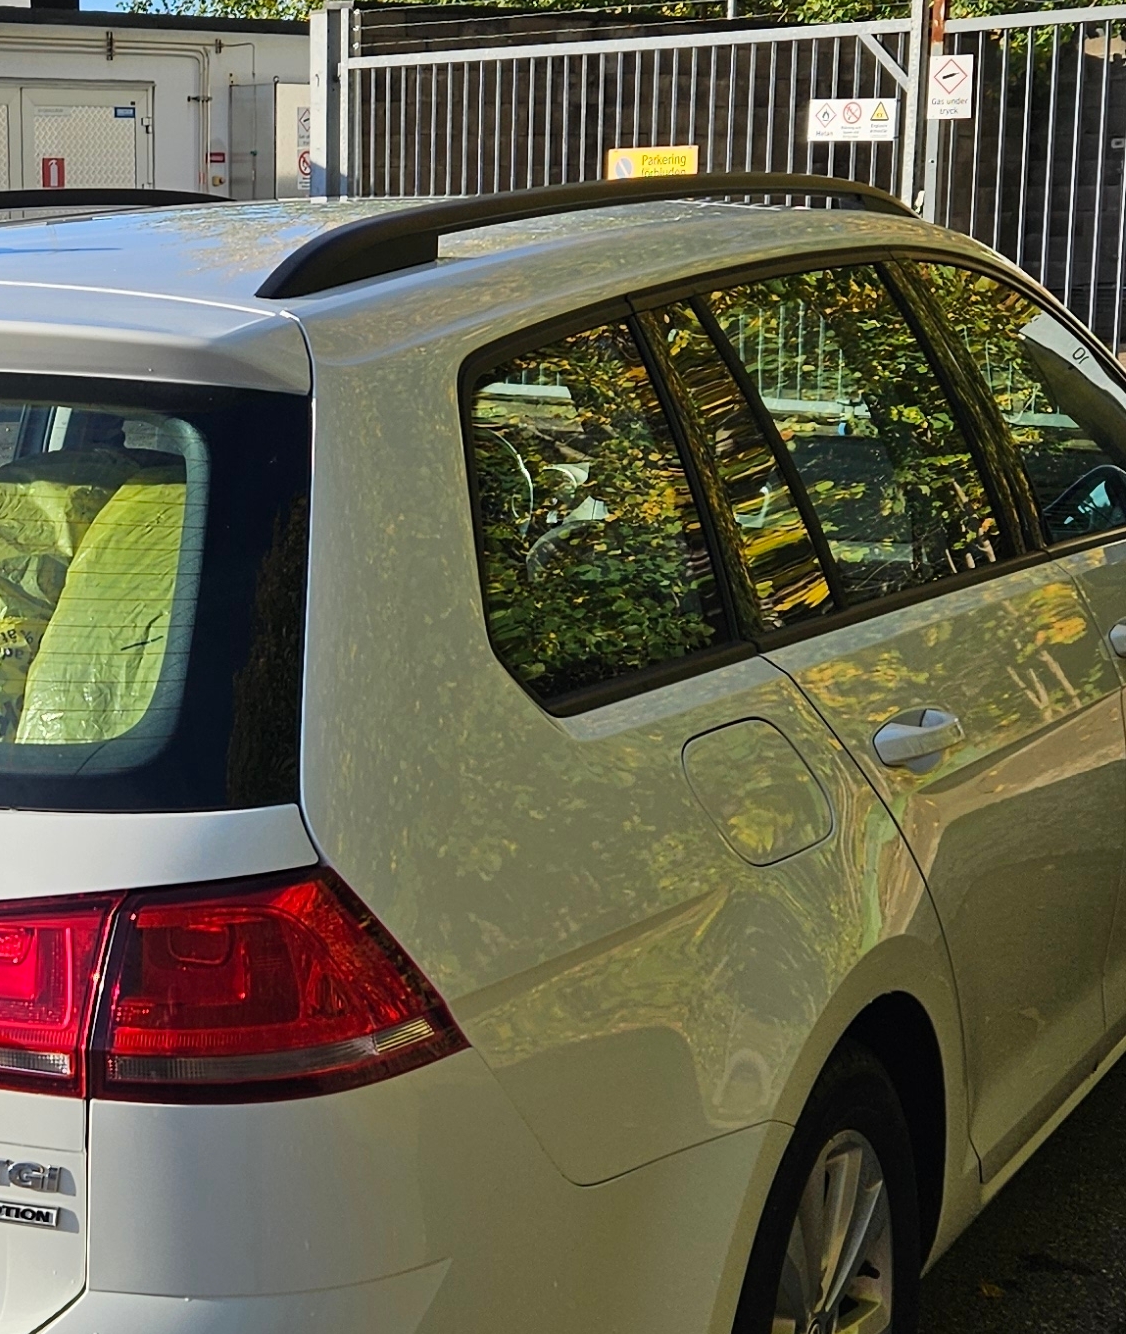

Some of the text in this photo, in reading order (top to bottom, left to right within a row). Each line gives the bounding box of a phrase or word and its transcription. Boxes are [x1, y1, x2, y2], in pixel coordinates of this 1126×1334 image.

[931, 97, 968, 105] Gas under
[641, 153, 687, 166] Parkering
